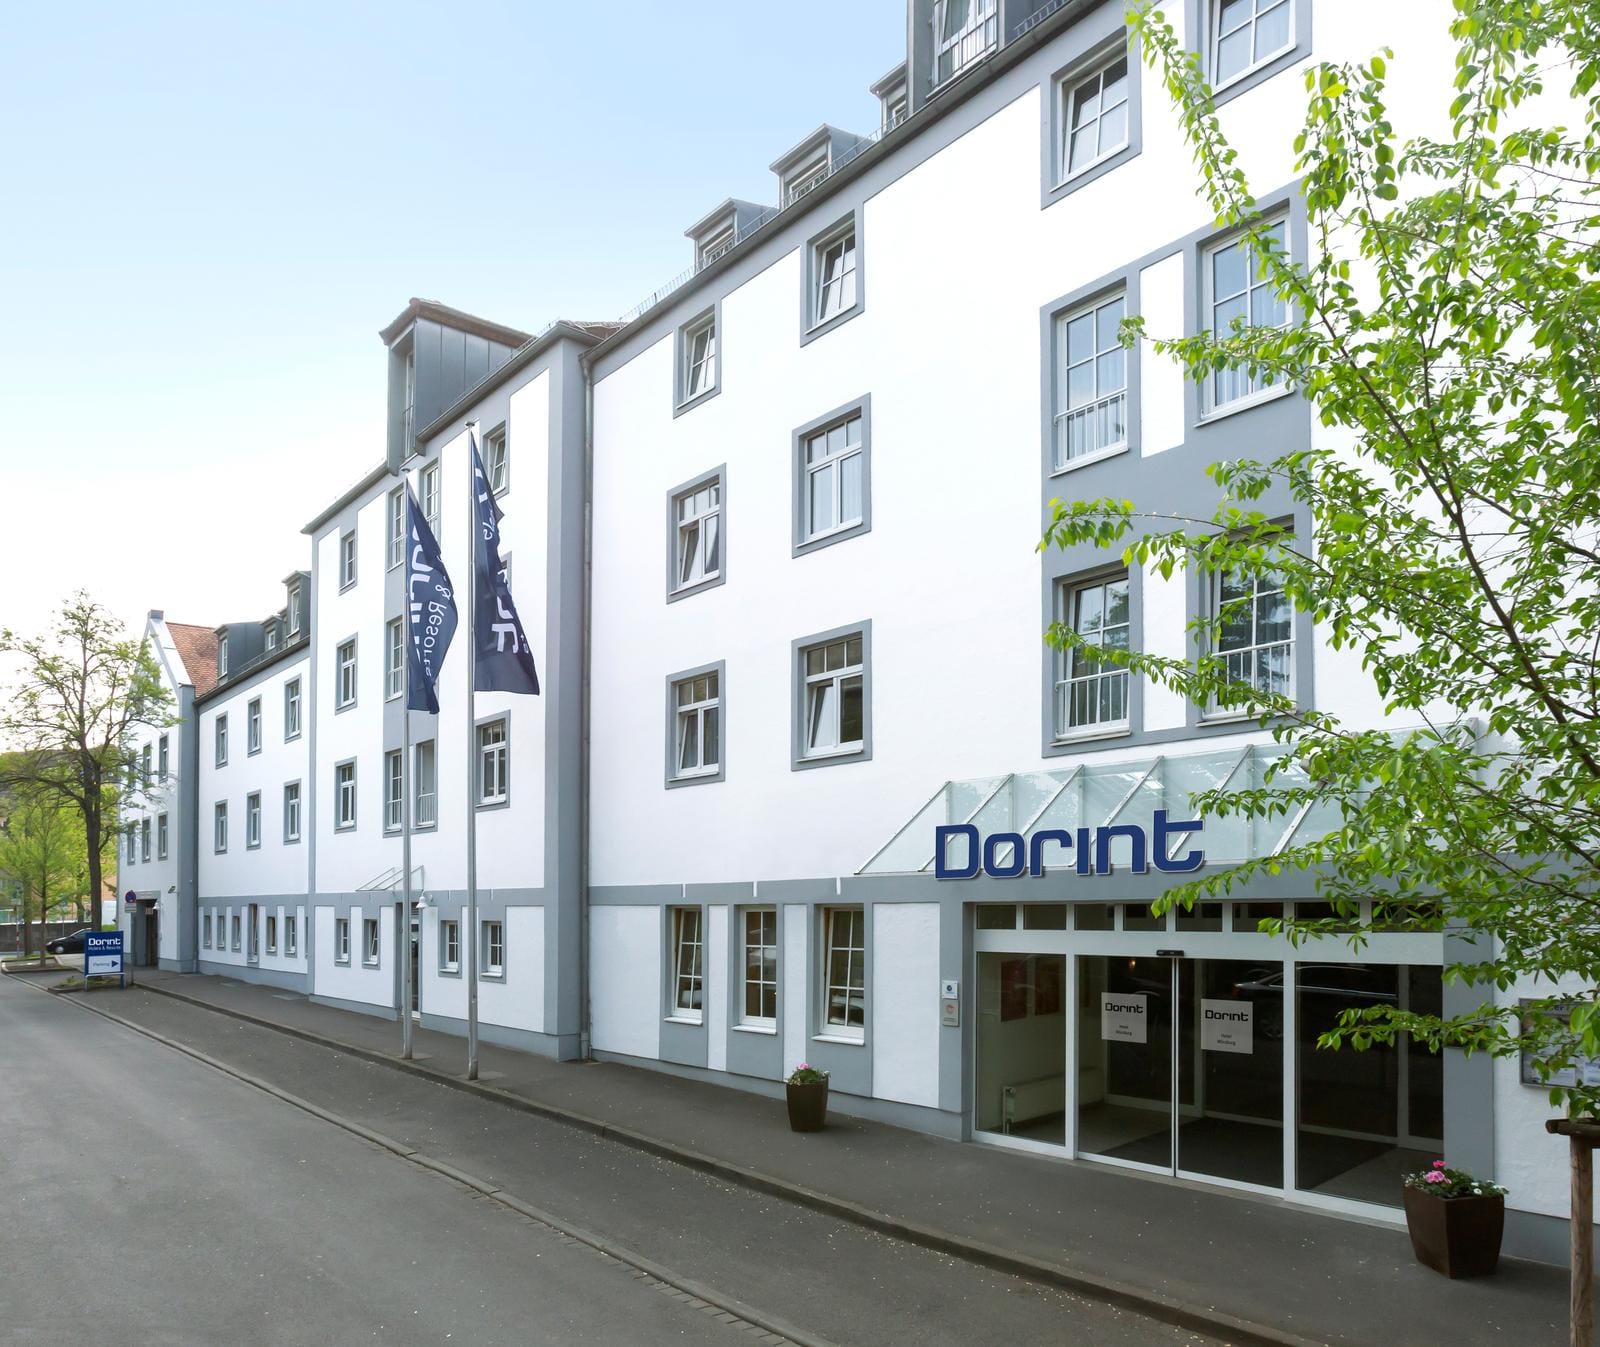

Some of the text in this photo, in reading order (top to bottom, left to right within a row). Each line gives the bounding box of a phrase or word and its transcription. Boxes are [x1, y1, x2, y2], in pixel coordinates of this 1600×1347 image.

[935, 809, 1204, 879] Dorint
[88, 938, 121, 946] Dorint
[1105, 1002, 1144, 1013] Dorint
[1205, 1010, 1249, 1022] Dorint
